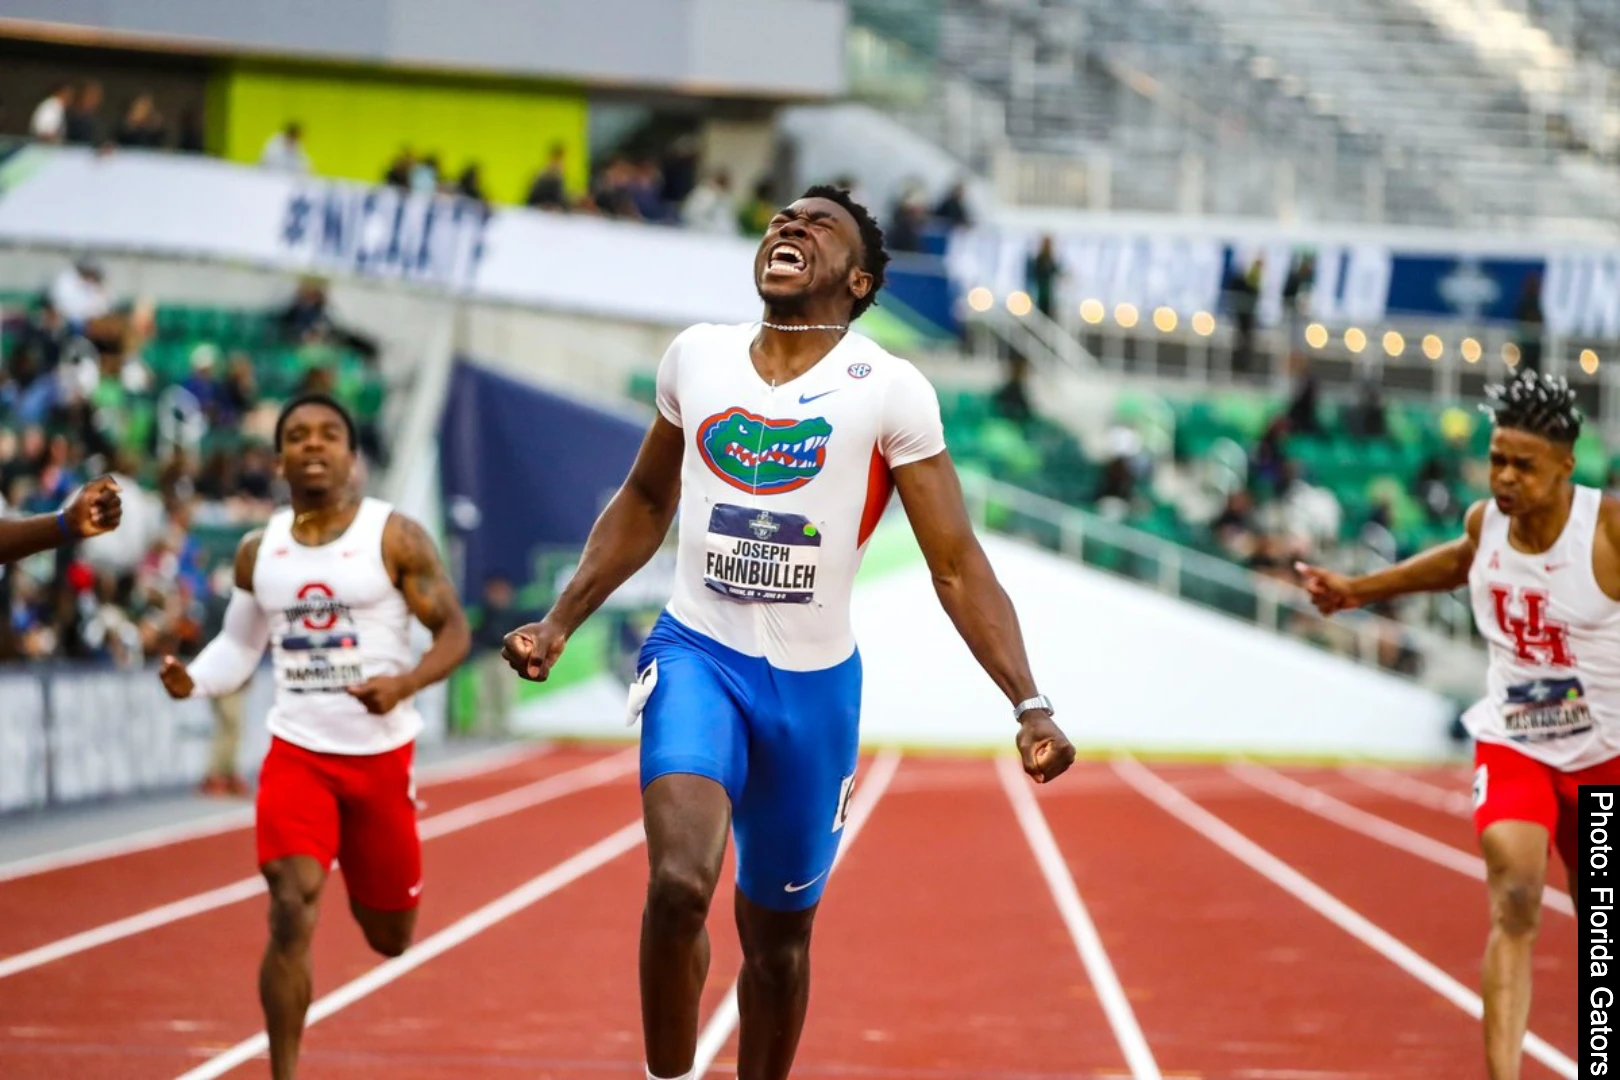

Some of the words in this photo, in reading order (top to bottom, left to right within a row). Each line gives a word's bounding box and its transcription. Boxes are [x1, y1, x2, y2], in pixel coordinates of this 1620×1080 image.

[706, 551, 816, 589] FAHNBULLEH
[732, 540, 790, 562] JOSEPH
[1488, 580, 1577, 669] UH
